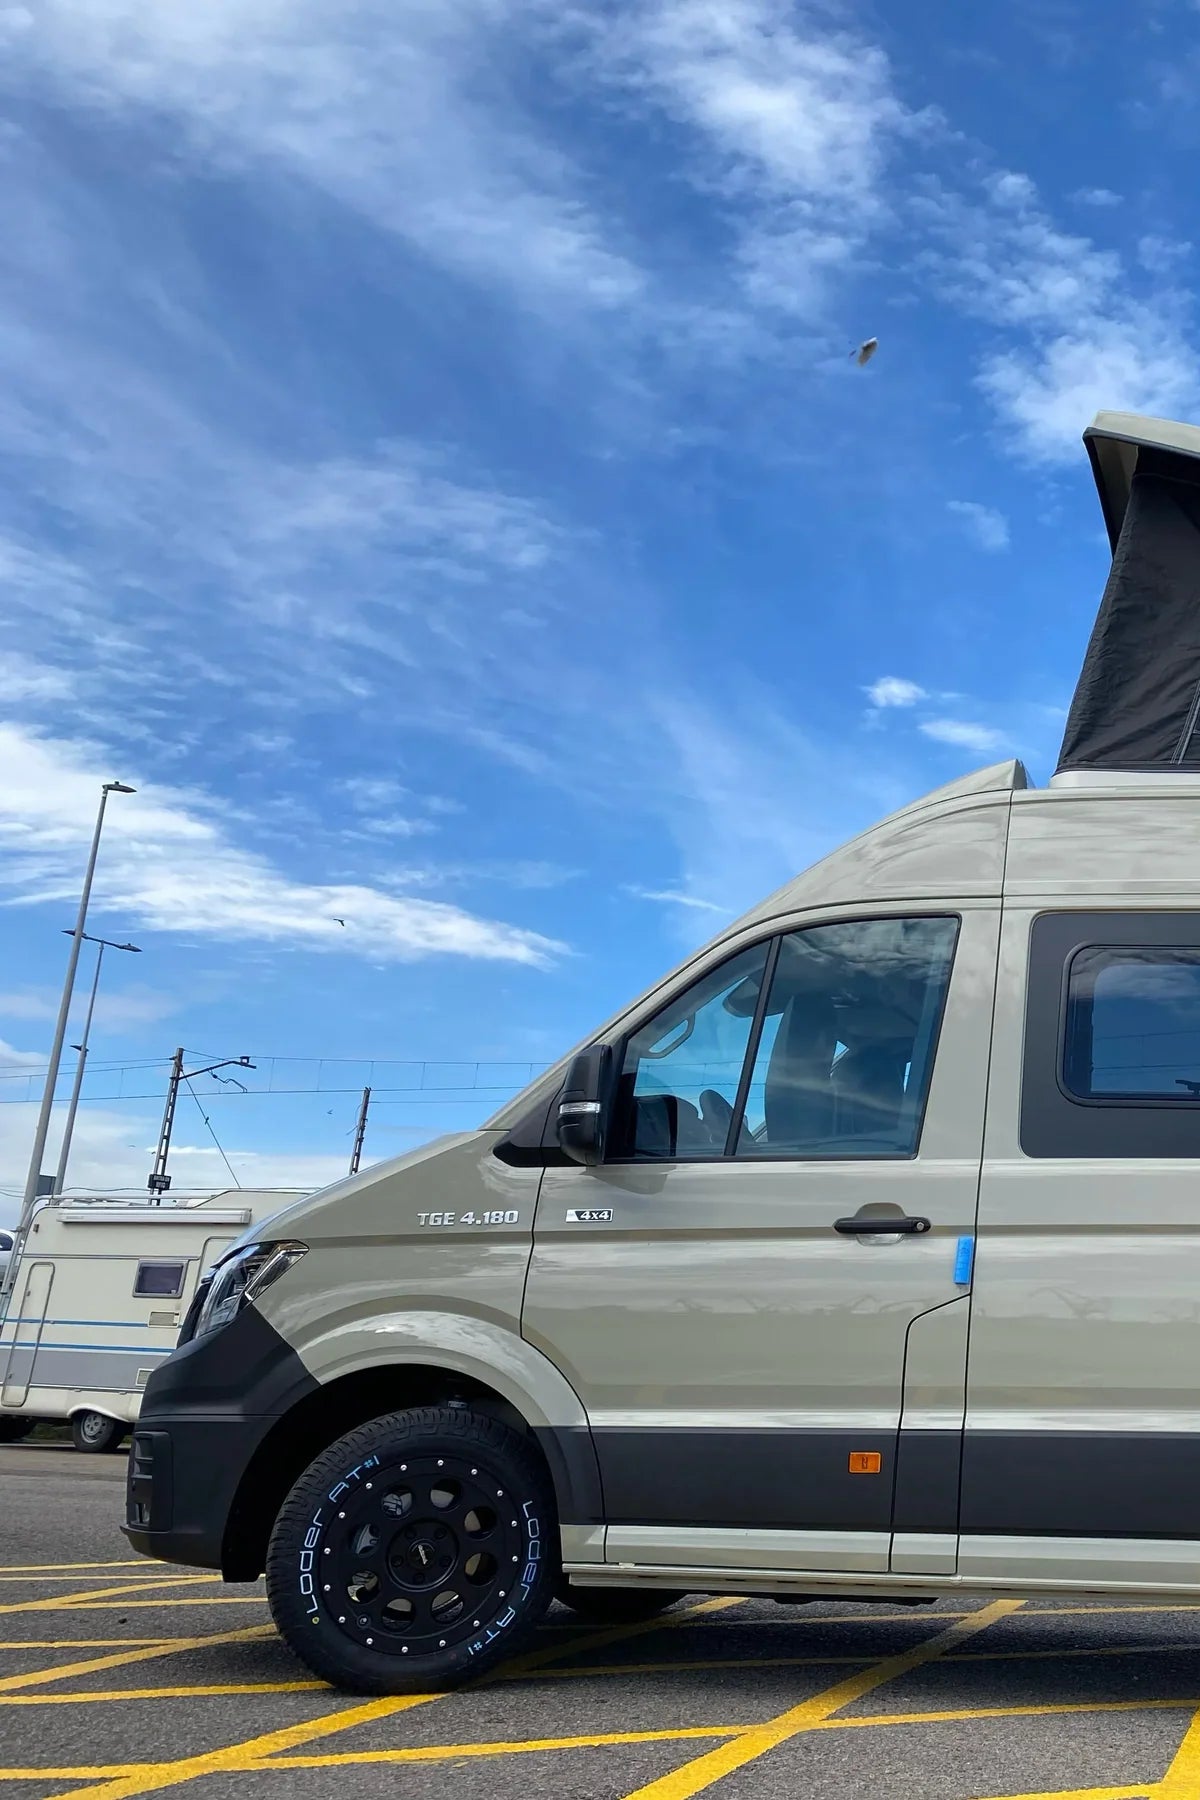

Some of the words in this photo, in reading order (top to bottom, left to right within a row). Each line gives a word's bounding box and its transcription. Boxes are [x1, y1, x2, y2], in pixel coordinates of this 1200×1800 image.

[416, 1211, 456, 1227] TGE
[459, 1209, 520, 1226] 4.180
[580, 1209, 611, 1220] 4x4
